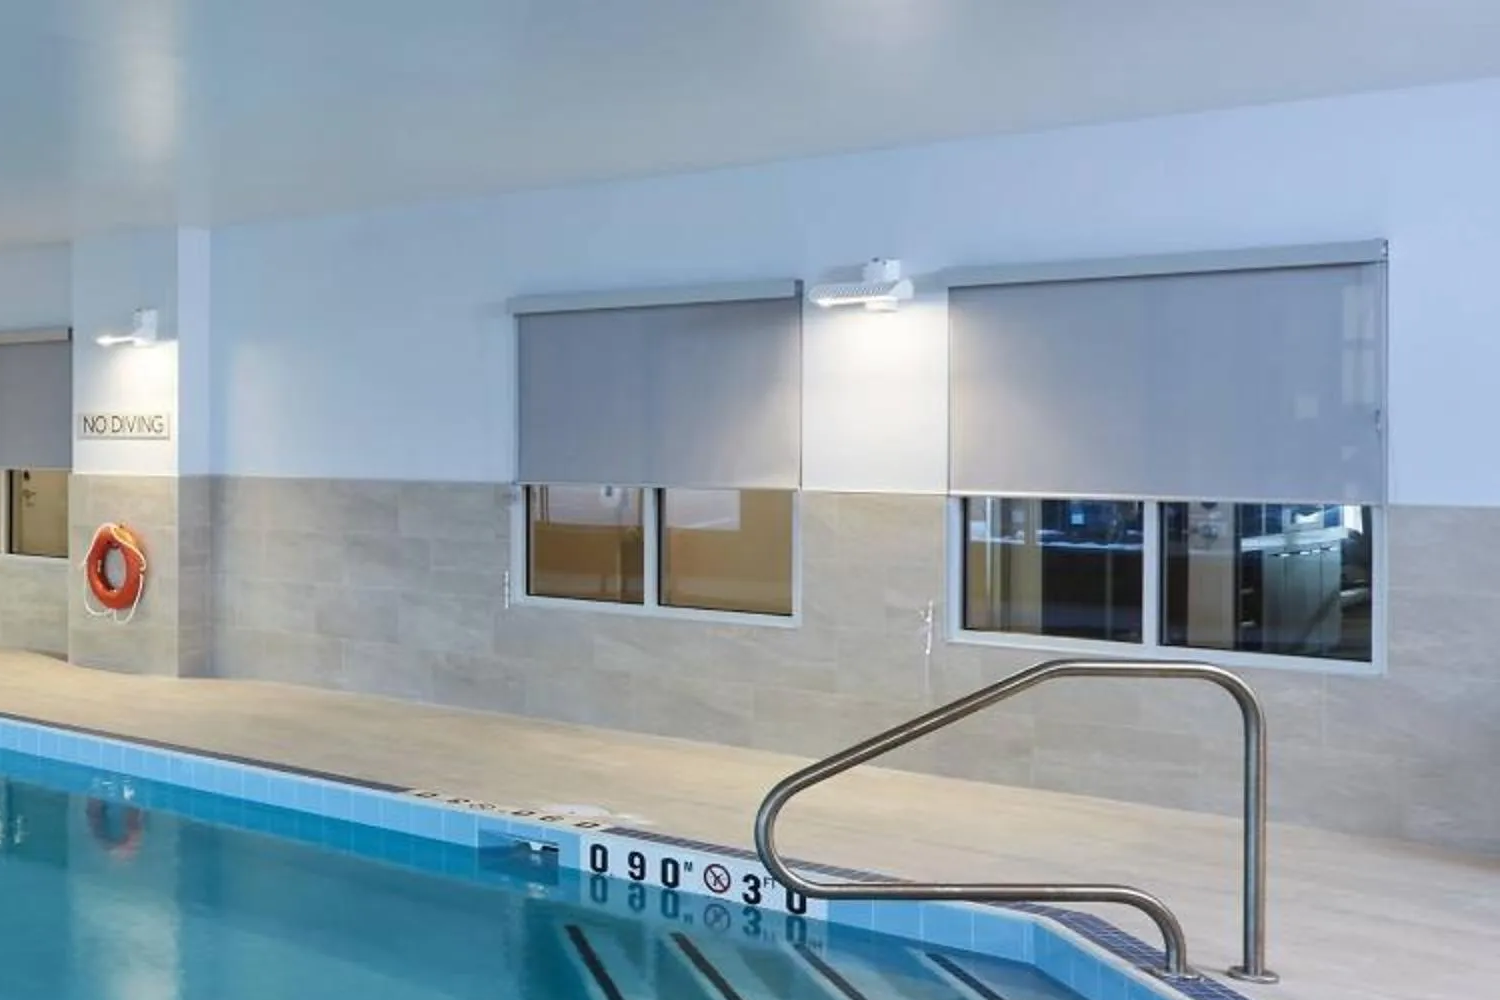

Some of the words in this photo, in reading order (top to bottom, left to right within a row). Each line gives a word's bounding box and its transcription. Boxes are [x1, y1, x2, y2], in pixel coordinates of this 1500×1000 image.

[83, 415, 107, 434] NO
[111, 415, 164, 434] DIVING
[742, 874, 762, 905] 3
